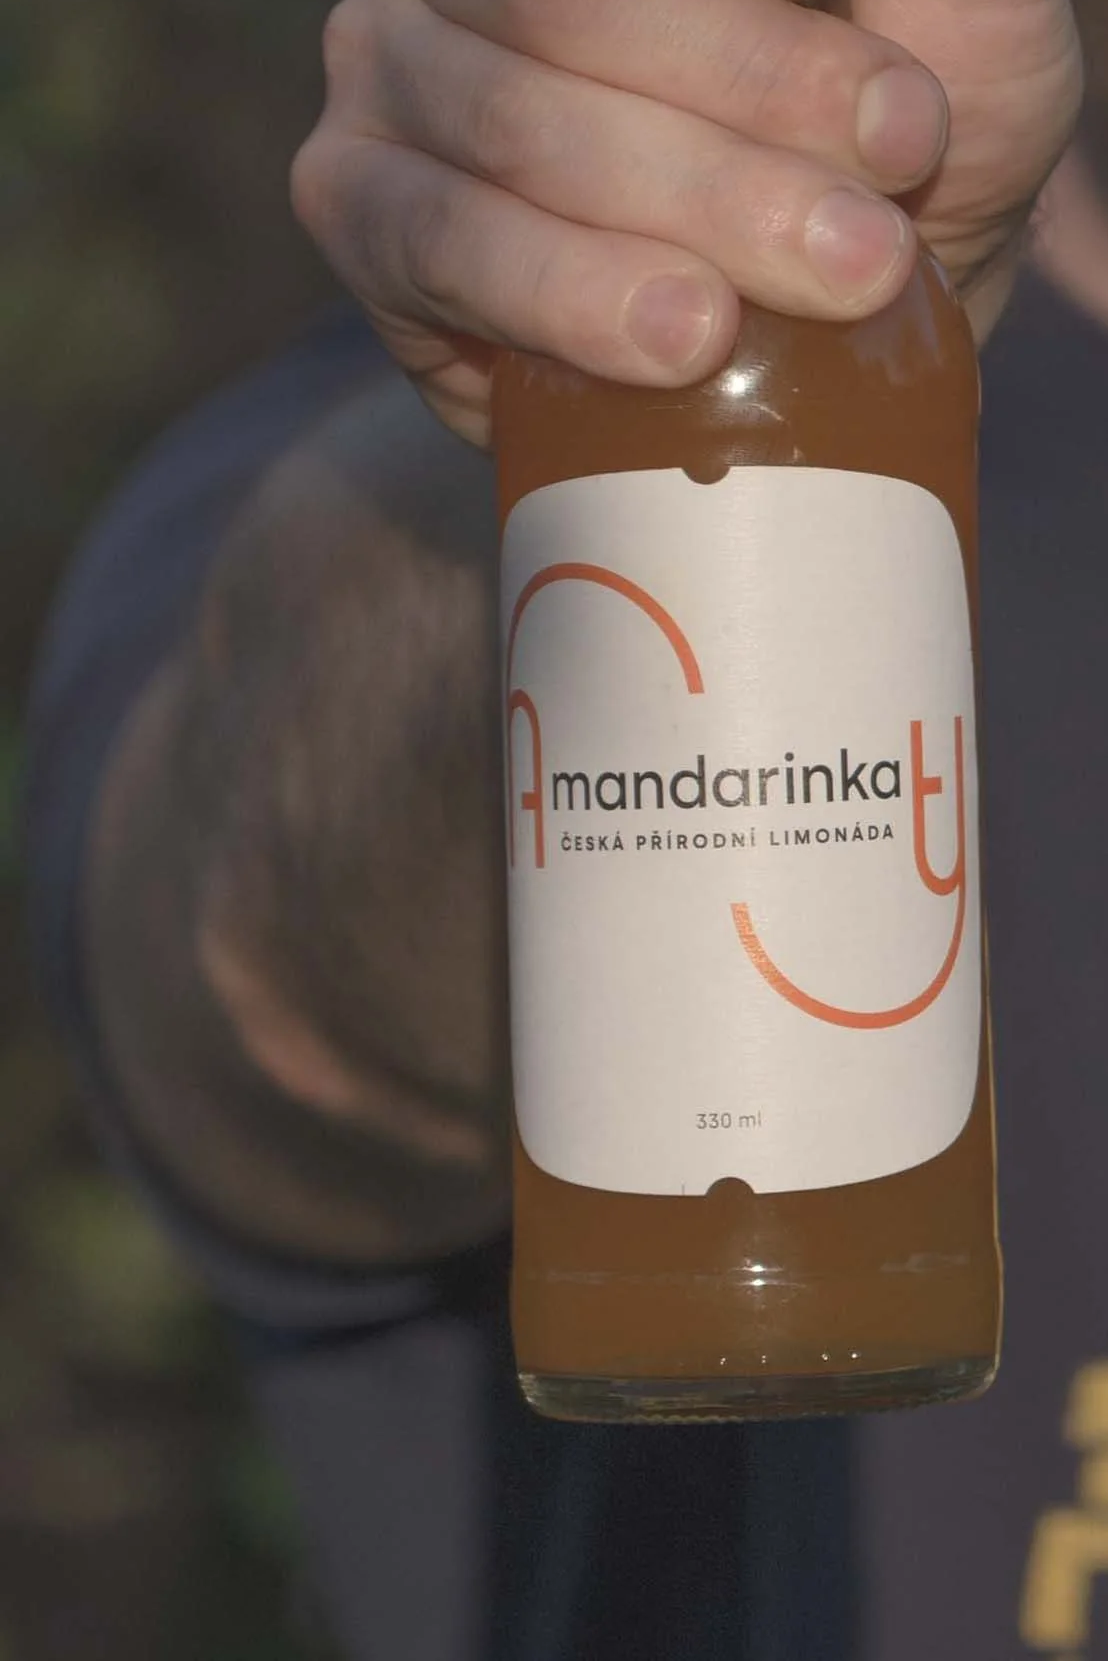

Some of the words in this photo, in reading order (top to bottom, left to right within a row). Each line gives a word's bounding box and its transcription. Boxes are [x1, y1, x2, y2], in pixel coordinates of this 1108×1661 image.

[560, 829, 624, 852] ČESKÁ
[636, 826, 756, 851] PŘÍRODNÍ
[769, 822, 895, 847] LIMONÁDA
[695, 1112, 732, 1130] 330
[738, 1109, 762, 1128] ml
